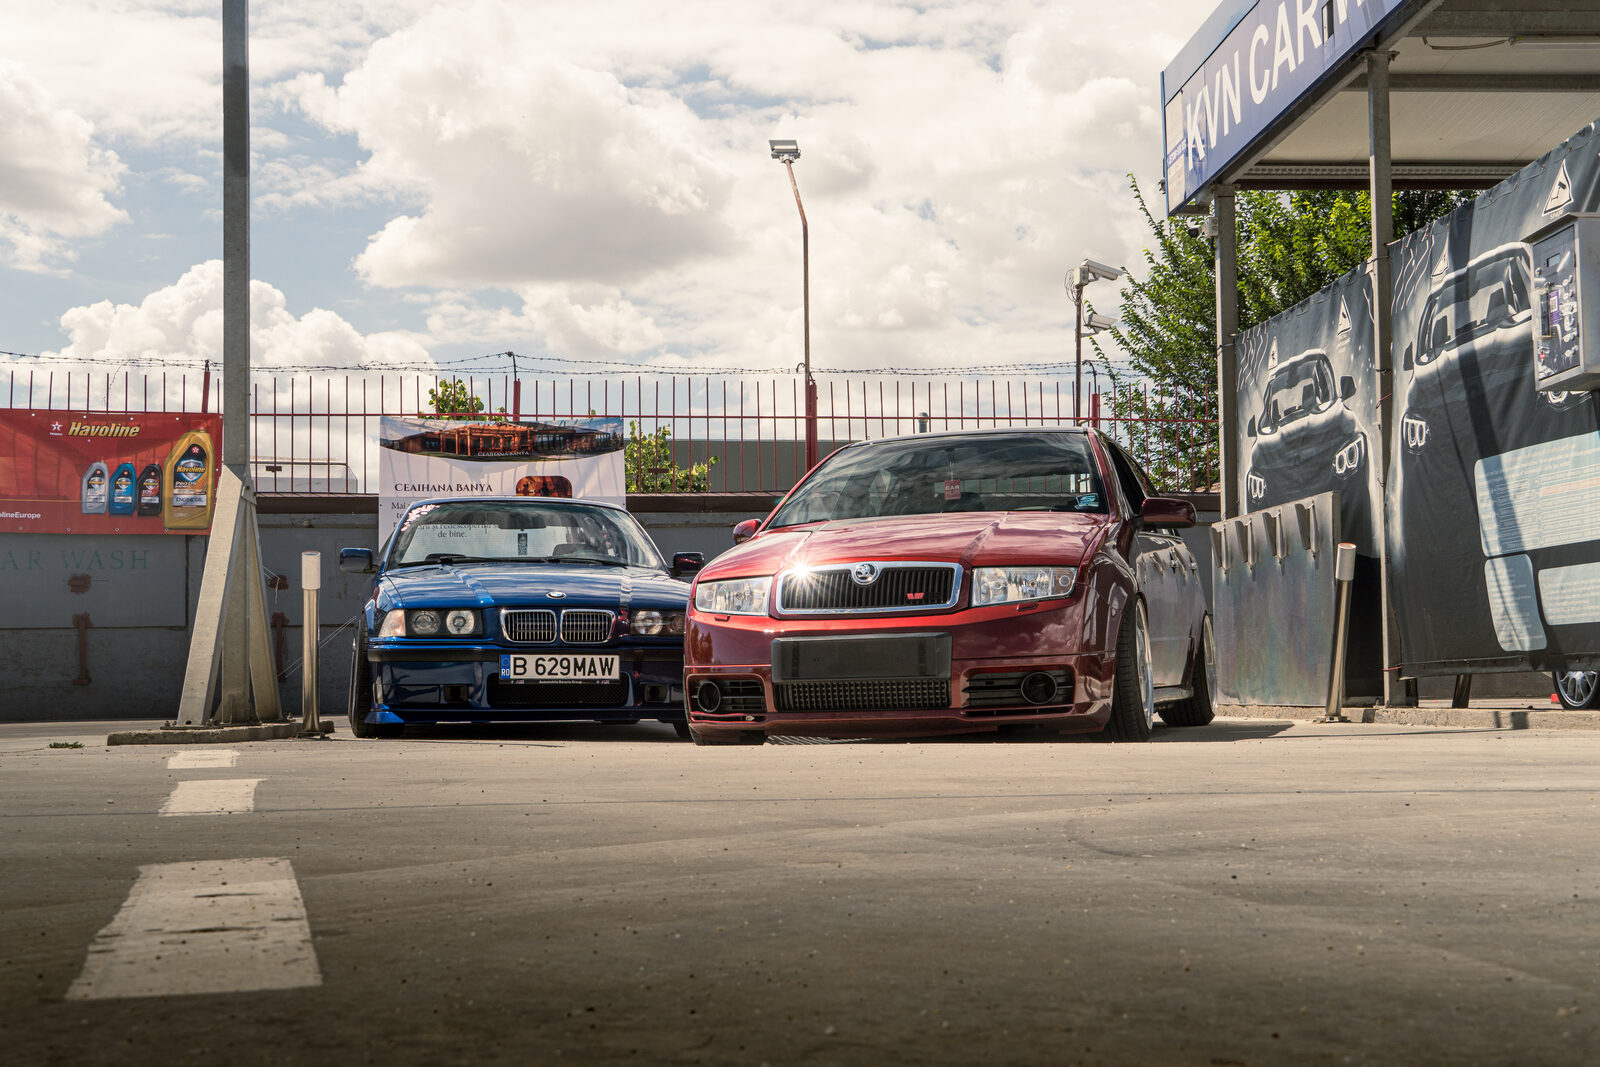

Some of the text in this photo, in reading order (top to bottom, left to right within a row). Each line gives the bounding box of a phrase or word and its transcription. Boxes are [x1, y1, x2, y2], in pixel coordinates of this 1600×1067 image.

[1186, 0, 1323, 172] KVN CAR
[68, 421, 140, 437] Havoline
[176, 465, 206, 473] Havoline
[394, 483, 493, 492] CEAIHANA BANYA
[437, 529, 468, 538] de bine.
[60, 549, 149, 570] WASH
[501, 668, 510, 677] RO
[513, 657, 527, 676] B
